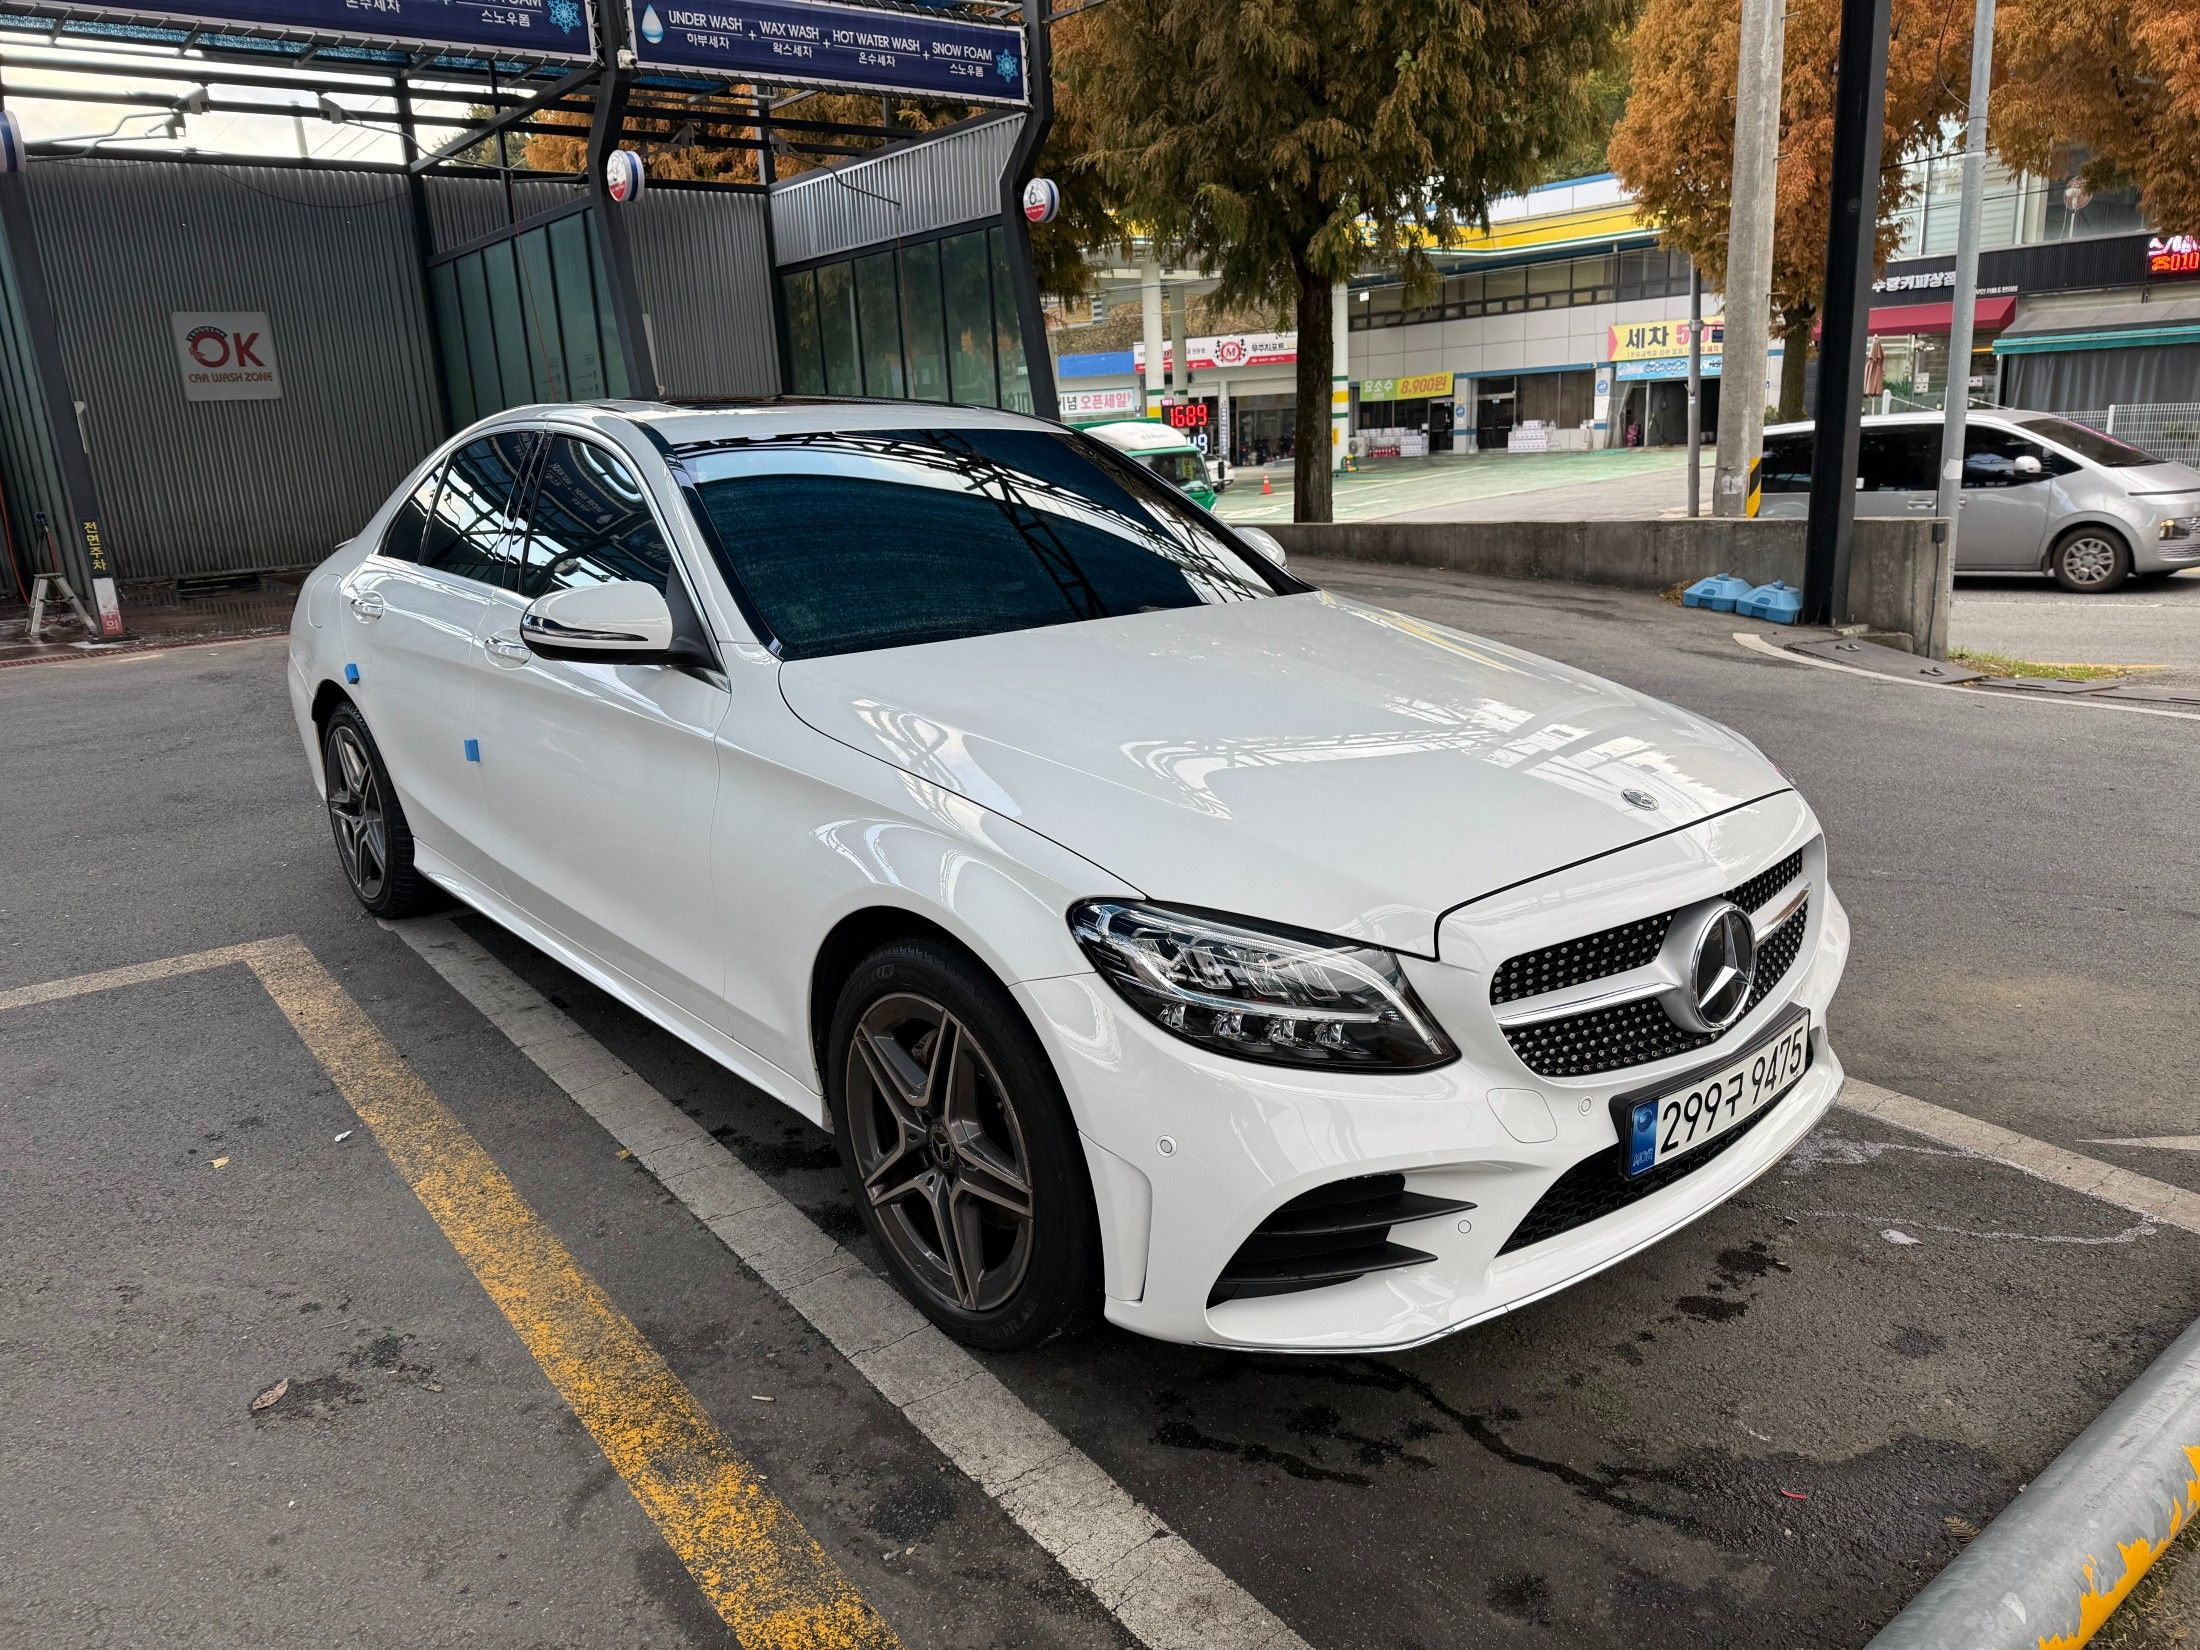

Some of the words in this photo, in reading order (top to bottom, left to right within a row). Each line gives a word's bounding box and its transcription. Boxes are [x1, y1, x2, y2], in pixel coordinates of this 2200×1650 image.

[481, 9, 530, 28] 스노우폼
[668, 10, 706, 28] UNDER
[710, 15, 743, 32] WASH
[758, 20, 788, 37] WAX
[787, 24, 820, 41] WASH
[832, 29, 855, 44] HOT
[856, 33, 891, 49] WATER
[890, 38, 920, 52] WASH
[932, 42, 962, 57] SNOW
[963, 47, 993, 61] FOAM
[686, 32, 730, 50] 하부세차
[772, 42, 813, 58] 왁스세차
[858, 52, 896, 68] 온수세차
[949, 63, 984, 78] 스노우폼
[1029, 185, 1037, 206] 6
[1625, 325, 1670, 349] 세차
[189, 331, 267, 368] OK
[1226, 347, 1236, 357] M
[188, 373, 210, 383] CAR
[211, 372, 243, 383] WASH
[244, 371, 273, 382] ZONE
[1364, 378, 1393, 393] 요소수
[1080, 392, 1128, 411] 오픈세일
[1170, 404, 1208, 428] 1689
[83, 521, 107, 572] 전면주차
[1660, 1071, 1745, 1155] 299구
[1751, 1026, 1804, 1106] 9475
